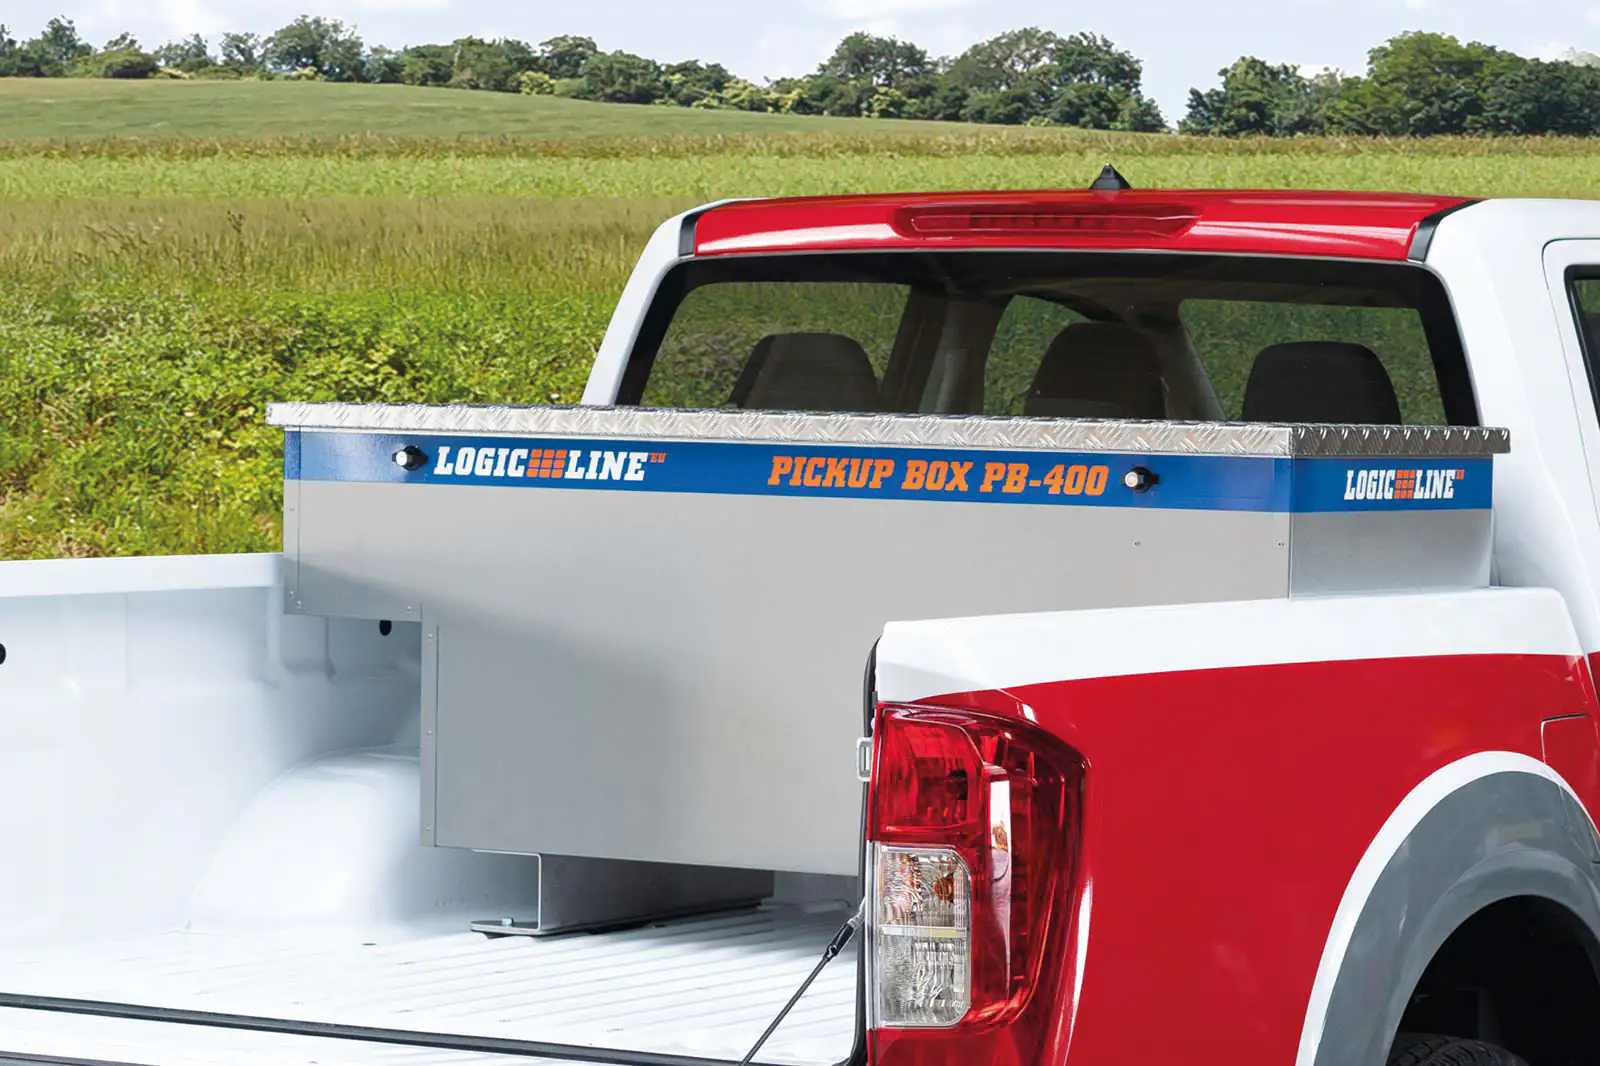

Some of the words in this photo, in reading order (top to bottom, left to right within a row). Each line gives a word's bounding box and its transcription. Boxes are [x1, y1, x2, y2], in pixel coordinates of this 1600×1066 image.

[434, 446, 528, 478] LOGIC
[564, 450, 648, 481] LINE
[767, 456, 894, 489] PICKUP
[901, 460, 973, 492] BOX
[979, 463, 1108, 496] PB-400
[1344, 469, 1396, 500] LOGIC
[1413, 469, 1456, 499] LINE
